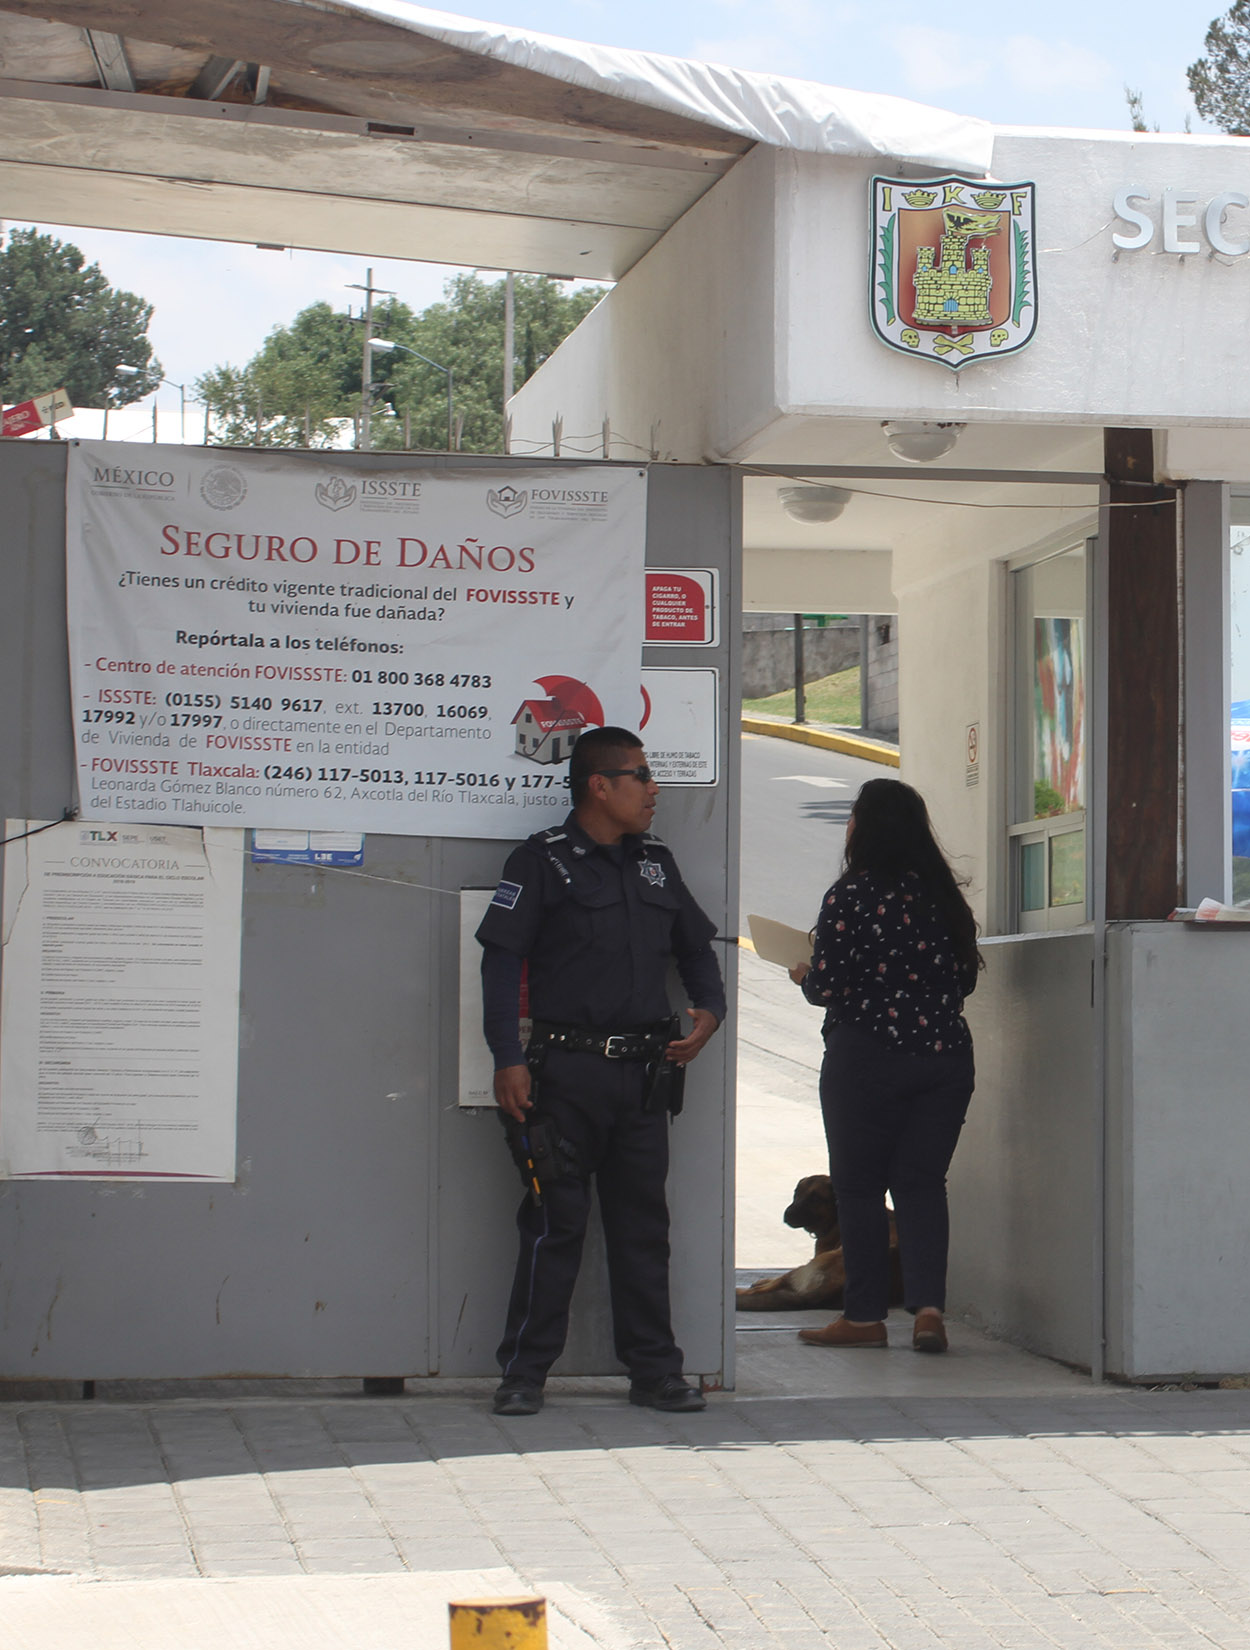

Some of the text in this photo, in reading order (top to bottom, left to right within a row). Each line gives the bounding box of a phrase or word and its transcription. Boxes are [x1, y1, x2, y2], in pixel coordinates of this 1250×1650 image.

[882, 186, 1027, 215] I K F
[93, 466, 174, 487] MÉXICO
[361, 480, 421, 496] ISSSTE
[531, 488, 608, 503] FOVISSSTE
[160, 525, 536, 573] SEGURO DE DAÑOS
[118, 570, 575, 610] ¿Tienes un crédito vigente tradicional del FOVISSSTE y
[248, 600, 445, 622] tu vivienda fue dañada?
[176, 629, 404, 654] Repórtala a los teléfonos:
[96, 657, 151, 674] Centro
[156, 660, 175, 675] de
[180, 662, 250, 678] atención
[255, 666, 348, 683] FOVISSSTE:
[352, 670, 372, 684] 01
[378, 671, 408, 686] 800
[414, 672, 444, 687] 368
[450, 674, 492, 688] 4783
[98, 689, 156, 706] ISSSTE:
[164, 692, 221, 710] (0155)
[230, 697, 272, 711] 5140
[281, 698, 326, 714] 9617,
[336, 702, 363, 715] ext.
[372, 702, 428, 718] 13700,
[436, 704, 492, 721] 16069,
[82, 709, 492, 740] 17992 y/o 17997, o directamente en el Departamento
[82, 730, 390, 756] de Vivienda de FOVISSSTE en la entidad
[92, 758, 178, 775] FOVISSSTE
[187, 762, 260, 779] Tlaxcala:
[264, 764, 312, 783] (246)
[318, 768, 408, 786] 117-5013,
[414, 772, 500, 788] 117-5016
[505, 777, 516, 791] y
[91, 796, 111, 808] del
[116, 797, 166, 812] Estadio
[92, 777, 155, 792] Leonarda
[160, 778, 211, 795] Gómez
[216, 782, 261, 796] Blanco
[266, 784, 318, 798] número
[324, 786, 346, 801] 62,
[352, 787, 403, 802] Axcotla
[408, 789, 427, 802] del
[433, 788, 453, 803] Río
[458, 790, 518, 806] Tlaxcala,
[522, 793, 557, 809] justo
[90, 830, 118, 842] TLX
[70, 856, 180, 870] CONVOCATORIA
